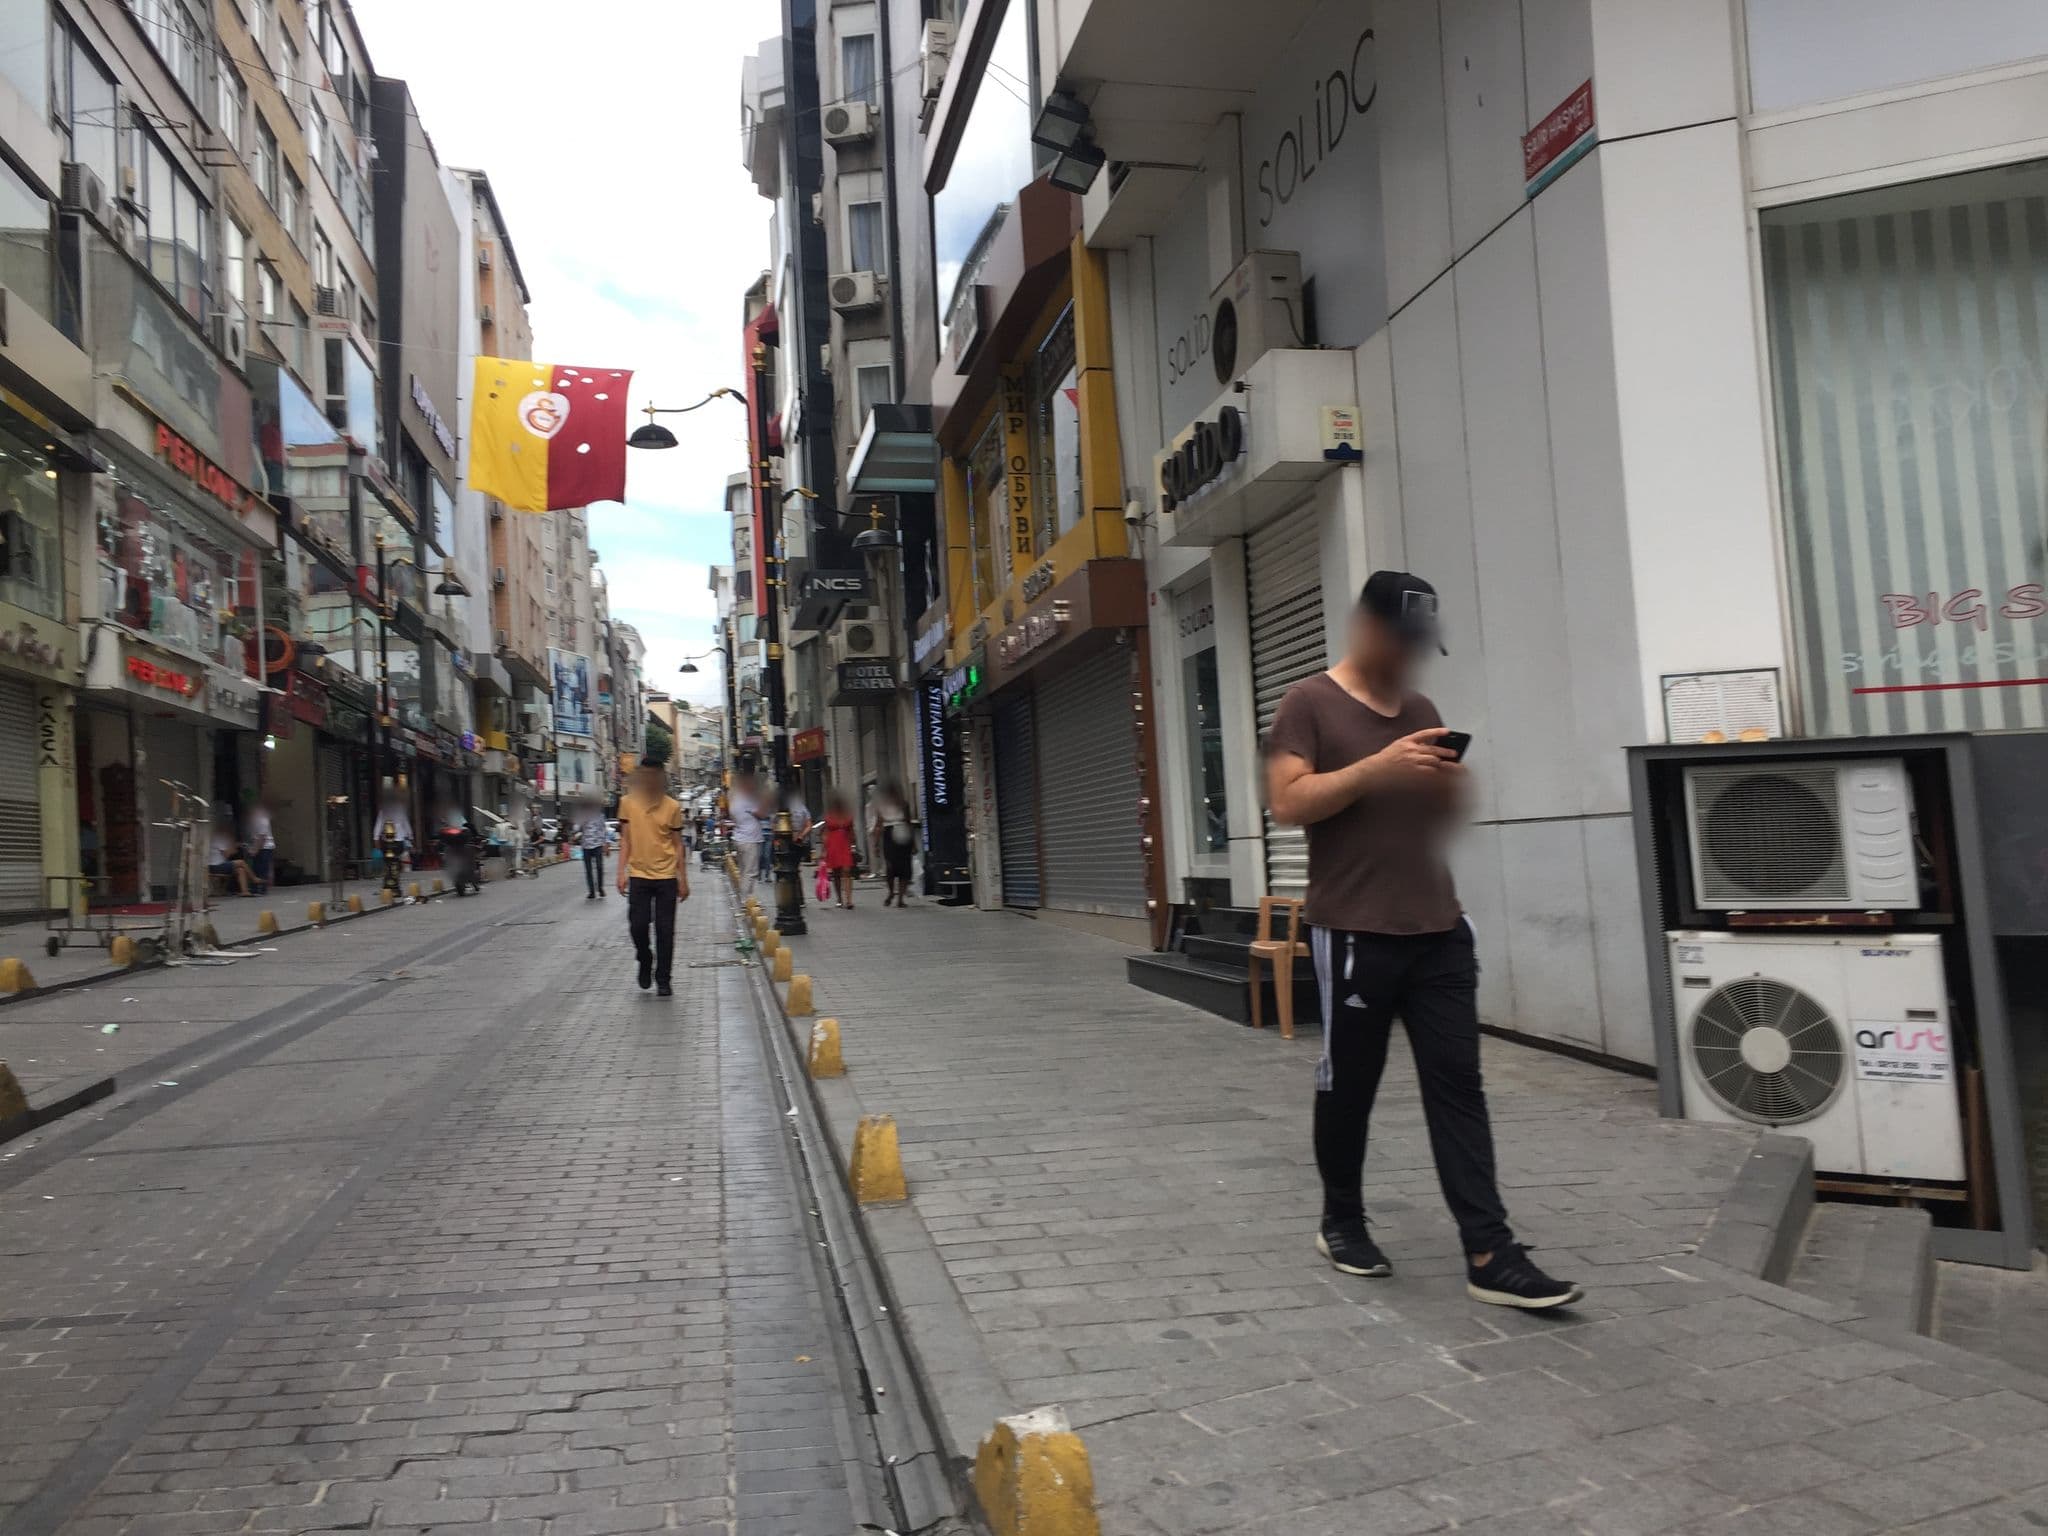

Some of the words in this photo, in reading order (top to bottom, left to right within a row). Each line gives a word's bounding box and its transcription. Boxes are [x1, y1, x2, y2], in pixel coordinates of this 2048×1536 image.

[1006, 375, 1024, 434] МИР
[1011, 455, 1031, 554] ОБУВИ
[812, 578, 862, 590] NCS
[1880, 588, 1988, 632] BIG
